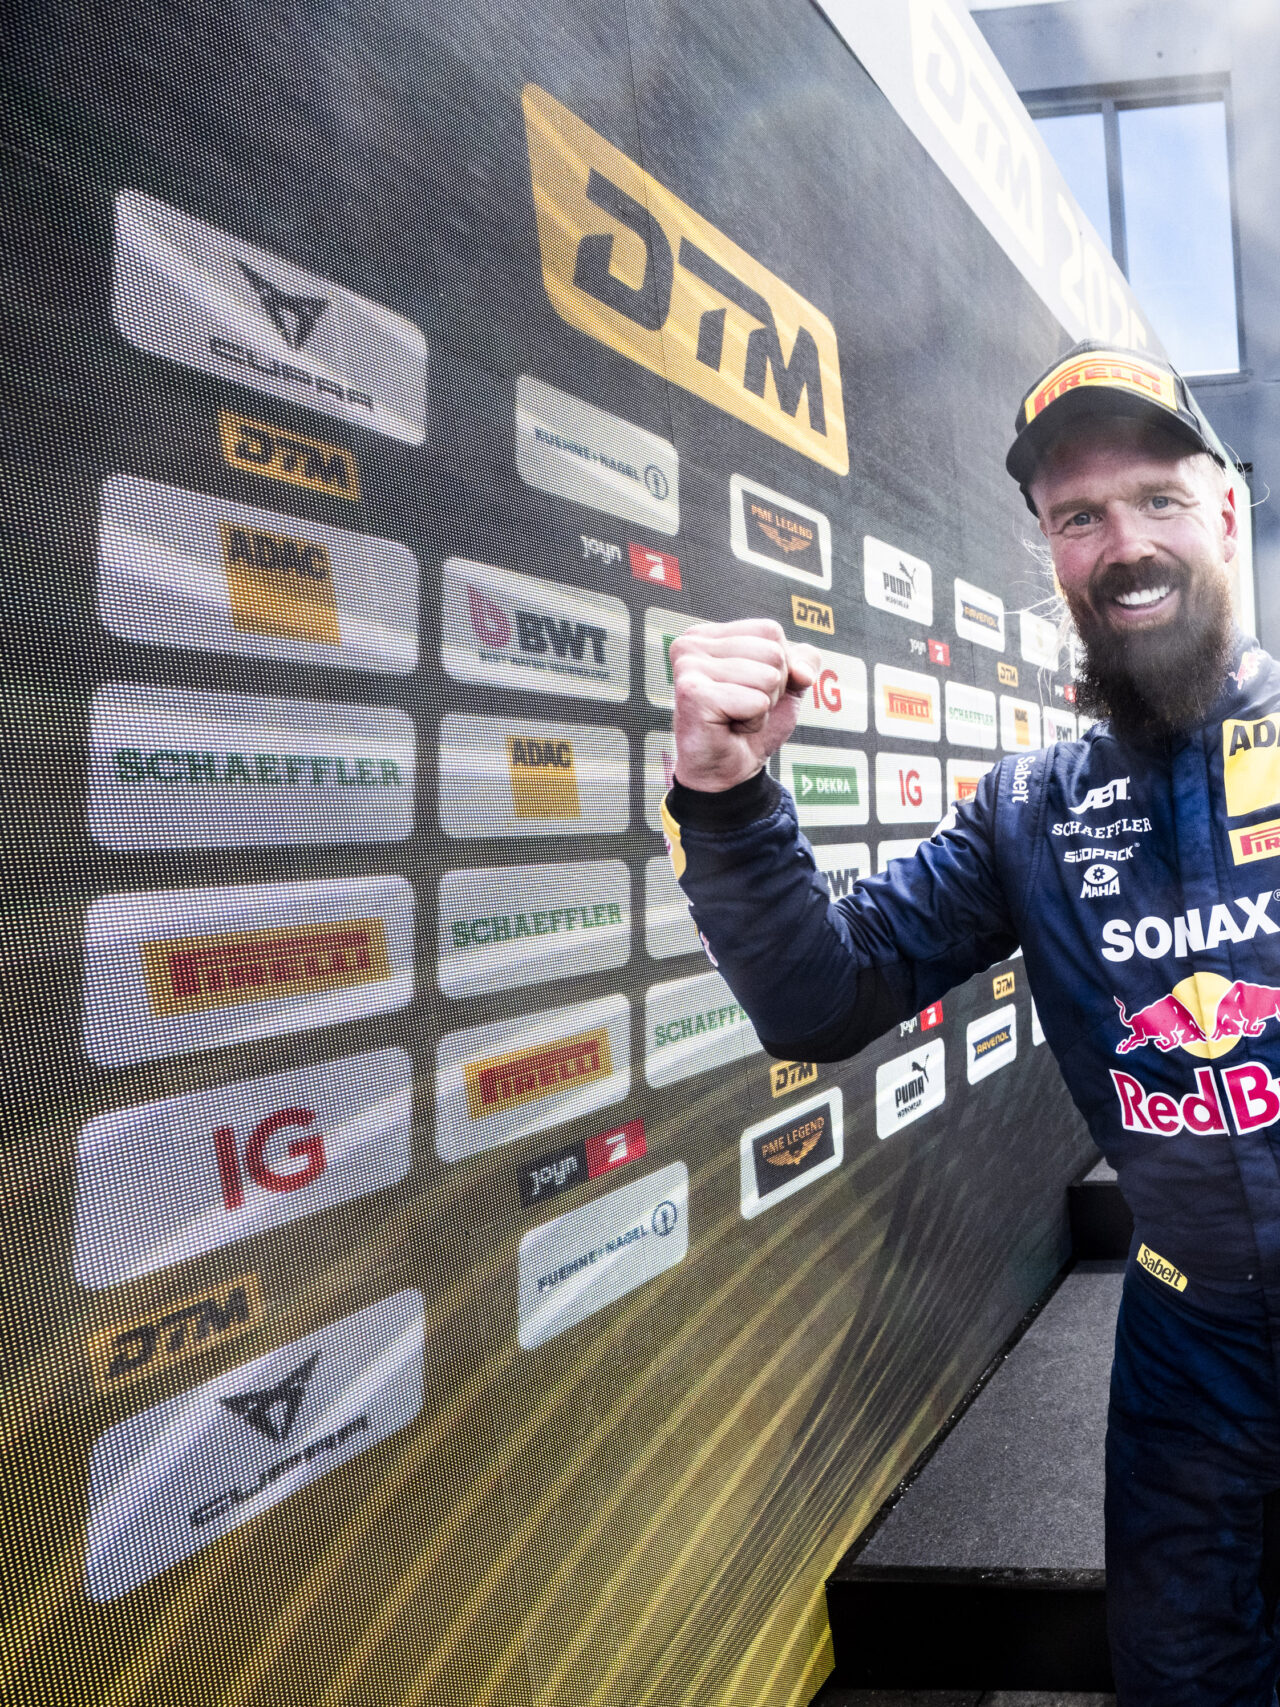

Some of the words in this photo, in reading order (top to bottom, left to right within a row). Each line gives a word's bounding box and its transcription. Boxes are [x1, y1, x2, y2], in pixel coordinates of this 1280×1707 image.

[925, 14, 1036, 238] DTM
[572, 167, 828, 438] DTM
[208, 336, 375, 412] CUPRA
[1034, 358, 1162, 416] PIRELLI
[234, 425, 351, 491] DTM
[751, 504, 773, 524] PME
[776, 514, 813, 540] LEGEND
[229, 529, 329, 581] ADAC
[882, 571, 912, 600] PUMA
[796, 602, 831, 629] DTM
[514, 609, 608, 664] BWT
[812, 669, 842, 713] IG
[888, 692, 930, 718] PIRELLI
[1056, 725, 1072, 741] BWT
[115, 748, 401, 785] SCHAEFFLER
[512, 739, 573, 768] ADAC
[816, 775, 852, 794] DEKRA
[899, 769, 923, 807] IG
[1012, 756, 1036, 804] Sabelt
[1068, 776, 1131, 815] ABT
[1051, 818, 1153, 839] SCHAEFFLER
[824, 868, 860, 897] WT
[1080, 877, 1121, 899] MAHA
[451, 902, 622, 948] SCHAEFFLER
[168, 931, 371, 997] PIRELLI
[996, 978, 1013, 995] DTM
[976, 1031, 1009, 1055] RAVENOL
[479, 1040, 601, 1105] PIRELLI
[776, 1061, 814, 1091] DTM
[895, 1076, 925, 1108] PUMA
[1109, 1066, 1231, 1137] Red
[762, 1136, 784, 1158] PME
[787, 1117, 825, 1144] LEGEND
[213, 1106, 328, 1211] IG
[530, 1155, 578, 1195] joyn
[1140, 1248, 1183, 1289] Sabelt
[109, 1286, 249, 1377] DTM
[190, 1414, 369, 1527] CUPRA
